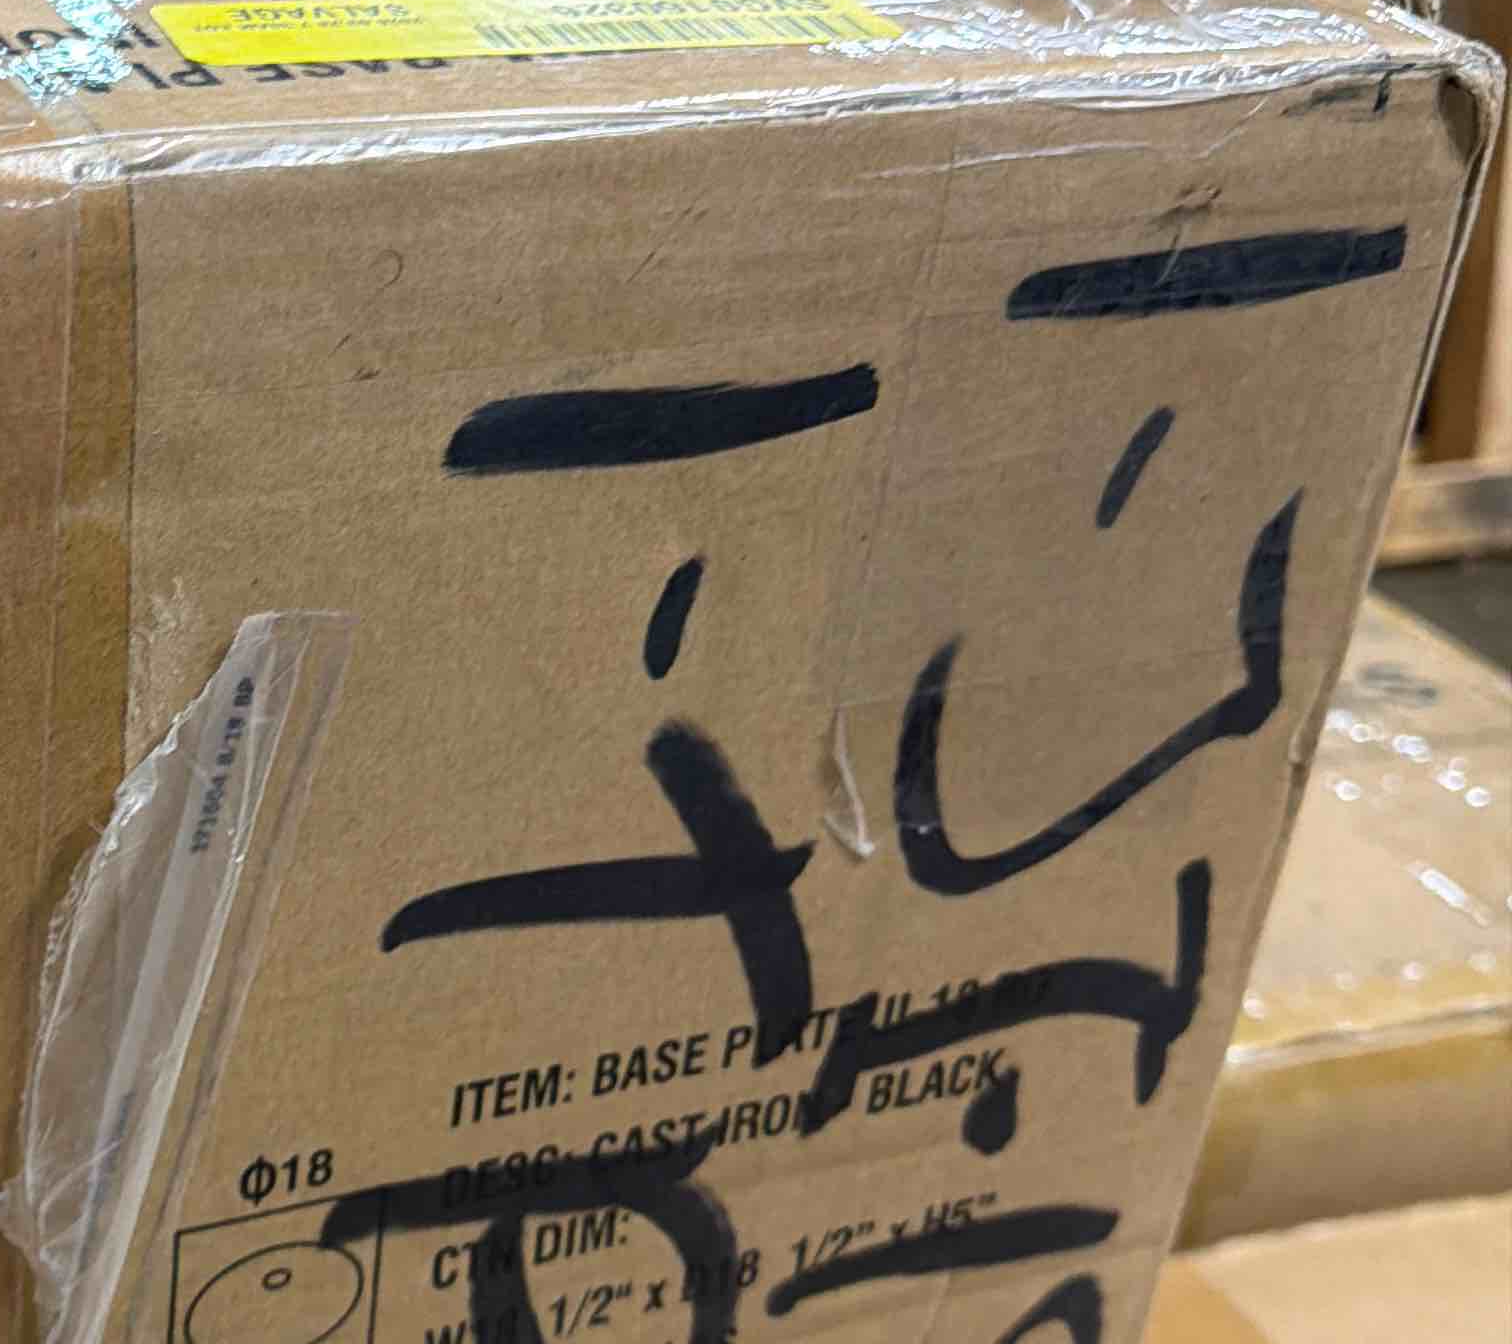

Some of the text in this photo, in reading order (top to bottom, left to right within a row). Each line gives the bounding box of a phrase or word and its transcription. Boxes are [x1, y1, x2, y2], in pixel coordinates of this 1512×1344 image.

[450, 1063, 576, 1129] ITEM:
[591, 1032, 711, 1097] BASE
[721, 1006, 856, 1071] PAT
[586, 1110, 710, 1180] CAST
[865, 1047, 1007, 1116] BLACK
[532, 1208, 634, 1266] DIM:
[643, 1279, 668, 1314] x
